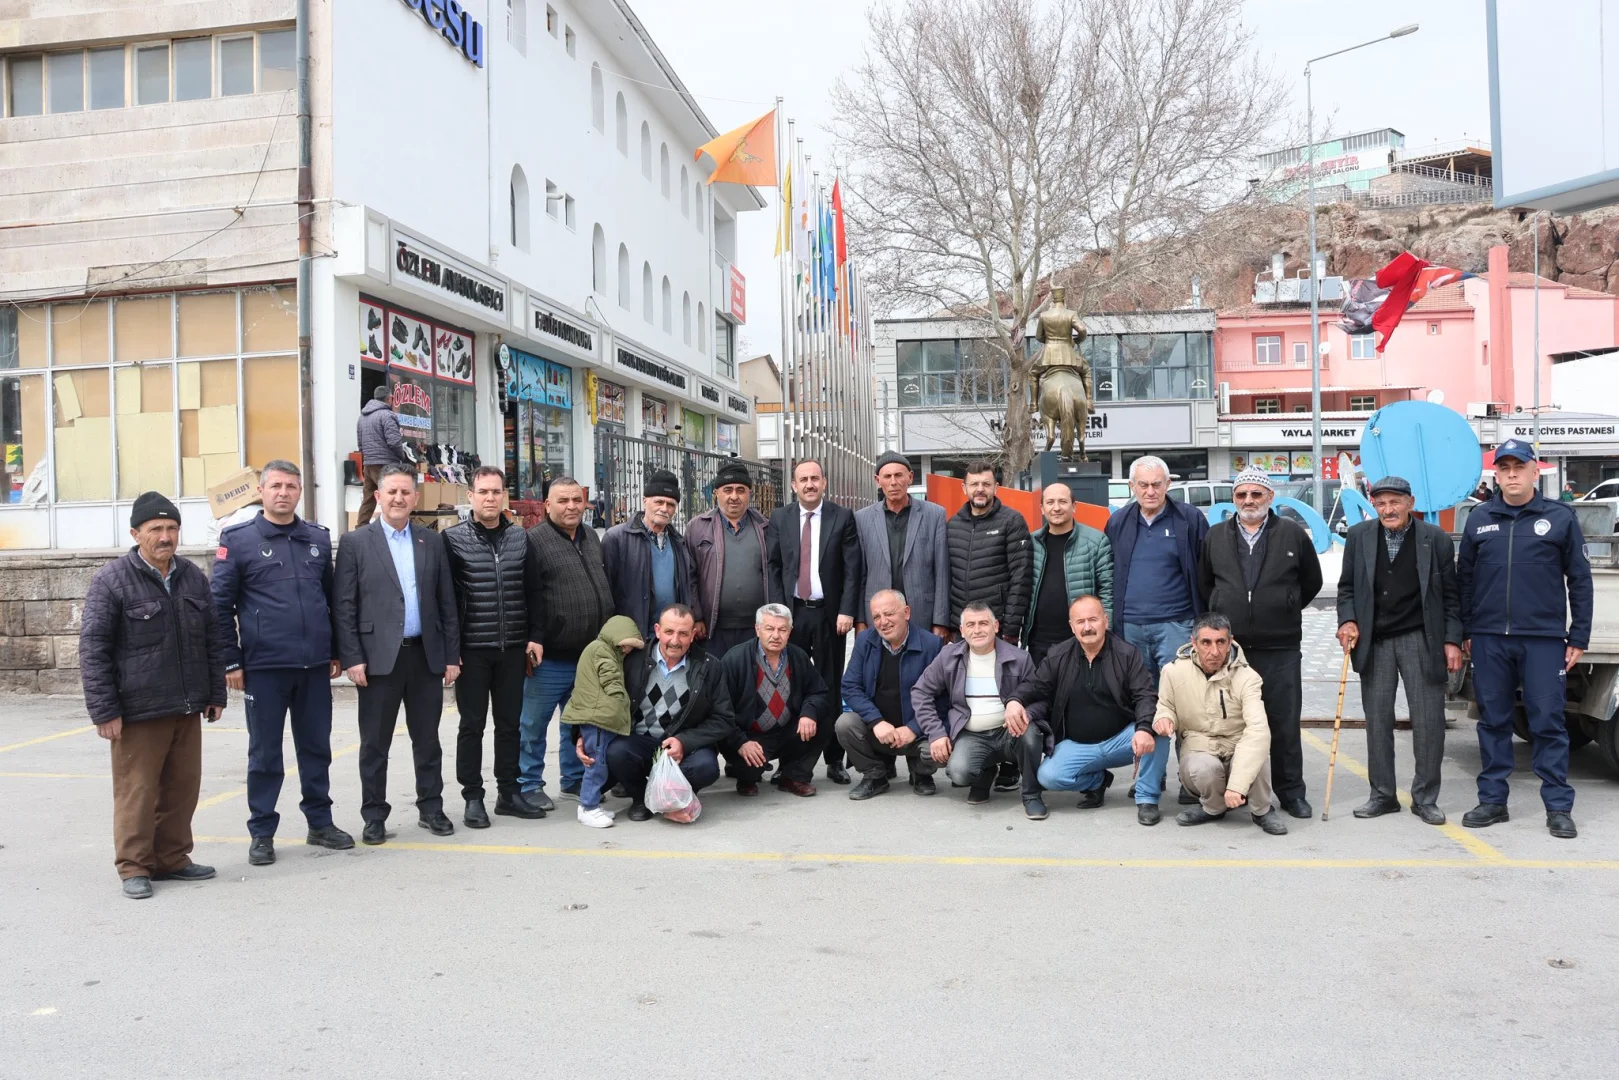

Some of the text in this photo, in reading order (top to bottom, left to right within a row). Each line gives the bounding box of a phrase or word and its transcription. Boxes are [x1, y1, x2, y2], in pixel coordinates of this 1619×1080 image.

[401, 0, 483, 68] esu
[396, 240, 441, 286] ÖZLEM
[393, 381, 431, 416] ÖZLEM
[1281, 429, 1357, 437] YAYLA ARKET
[1515, 425, 1615, 435] ÖZ ECİYES PASTANESİ
[224, 482, 251, 500] DERBY
